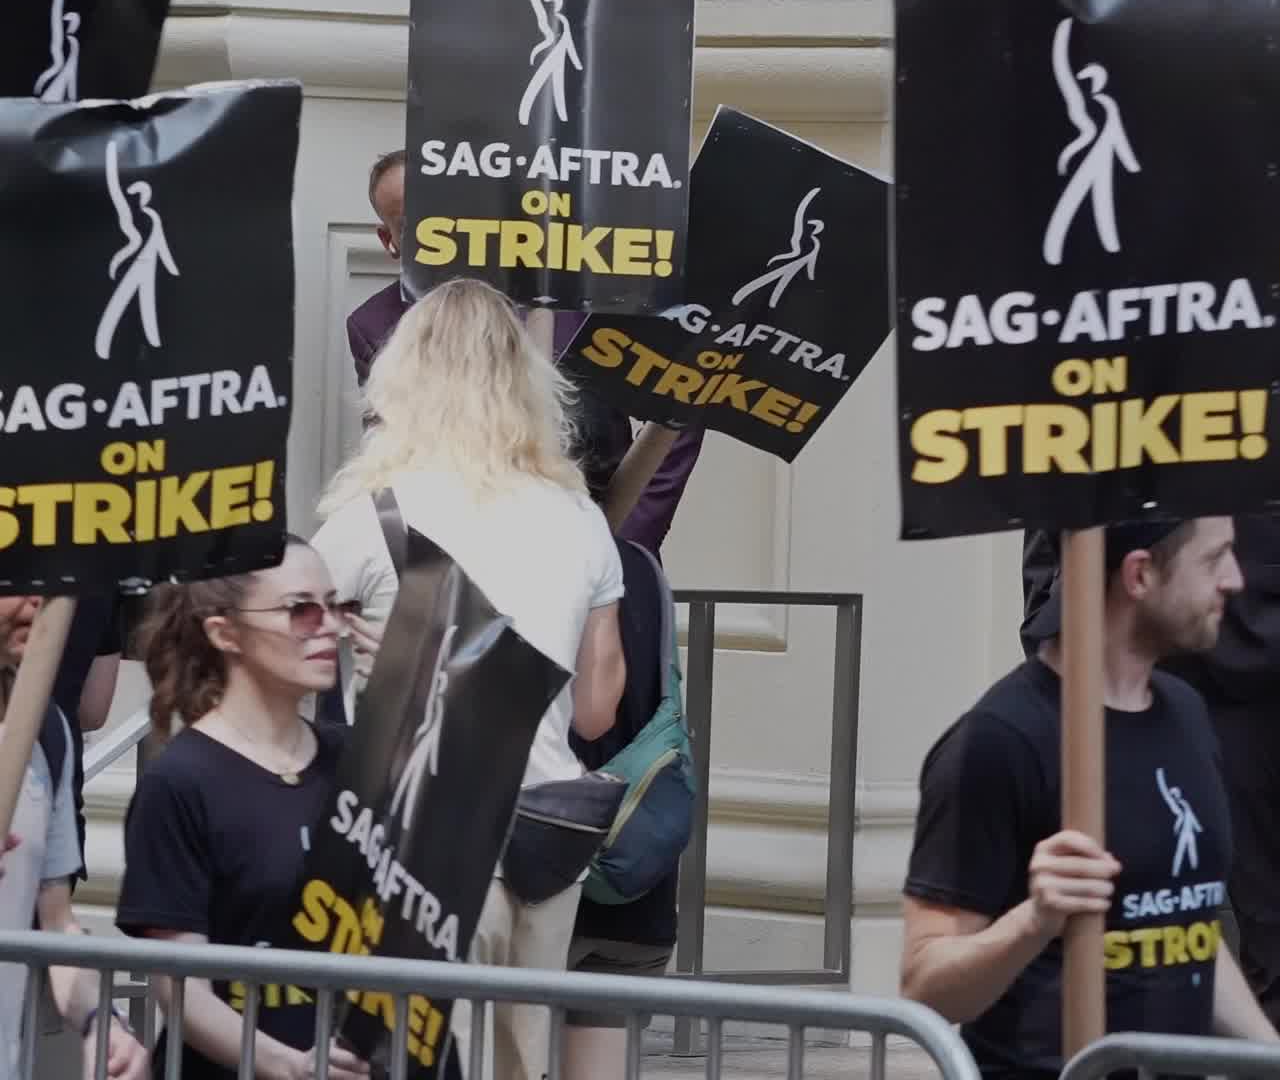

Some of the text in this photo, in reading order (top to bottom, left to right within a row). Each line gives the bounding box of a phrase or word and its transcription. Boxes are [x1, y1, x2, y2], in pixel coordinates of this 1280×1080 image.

[521, 190, 571, 217] ON
[414, 217, 675, 278] STRIKE!
[581, 327, 823, 434] STRIKE!
[696, 350, 745, 370] ON
[1052, 356, 1128, 397] ON
[0, 365, 287, 434] AG·AFTRA.
[101, 439, 165, 475] ON
[910, 389, 1269, 485] STRIKE!
